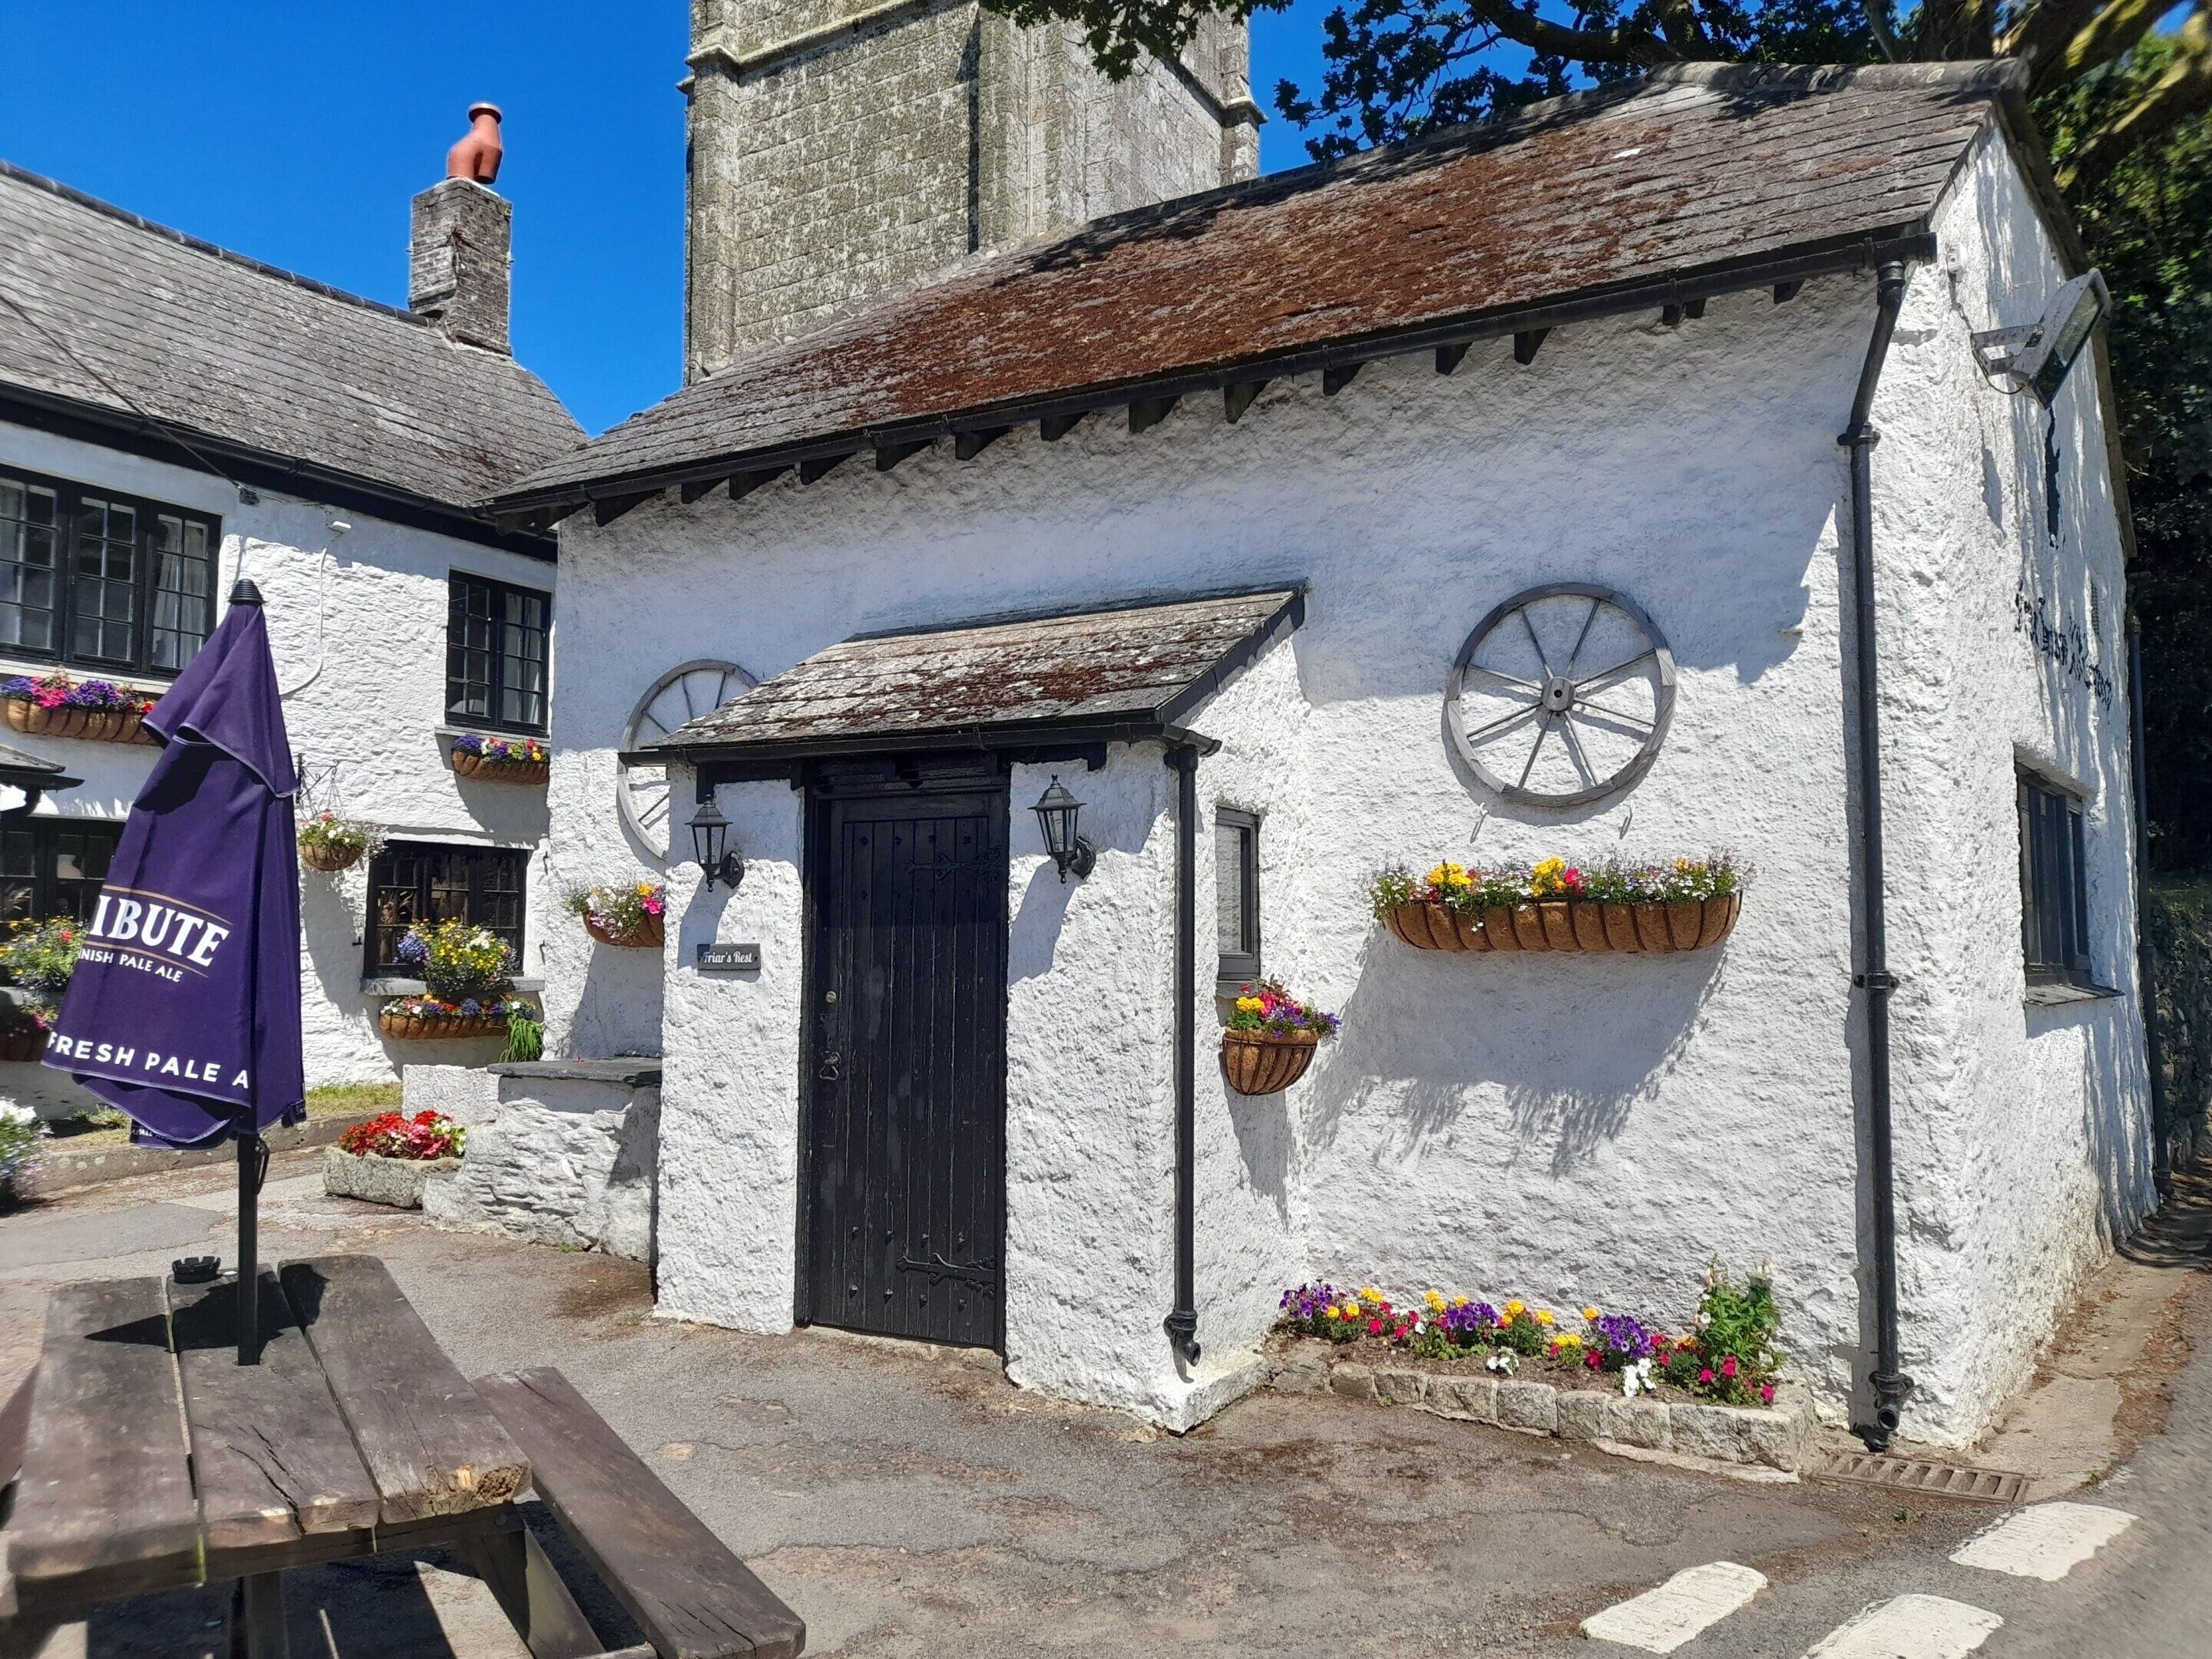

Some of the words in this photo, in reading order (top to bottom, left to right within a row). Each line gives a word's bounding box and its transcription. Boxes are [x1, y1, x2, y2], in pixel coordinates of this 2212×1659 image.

[89, 894, 230, 967] IBUTE
[118, 953, 154, 972] PALE
[154, 965, 184, 983] ALE
[703, 951, 732, 963] Friar's
[733, 950, 752, 963] Rest
[144, 1053, 221, 1082] PALE
[231, 1069, 249, 1089] A
